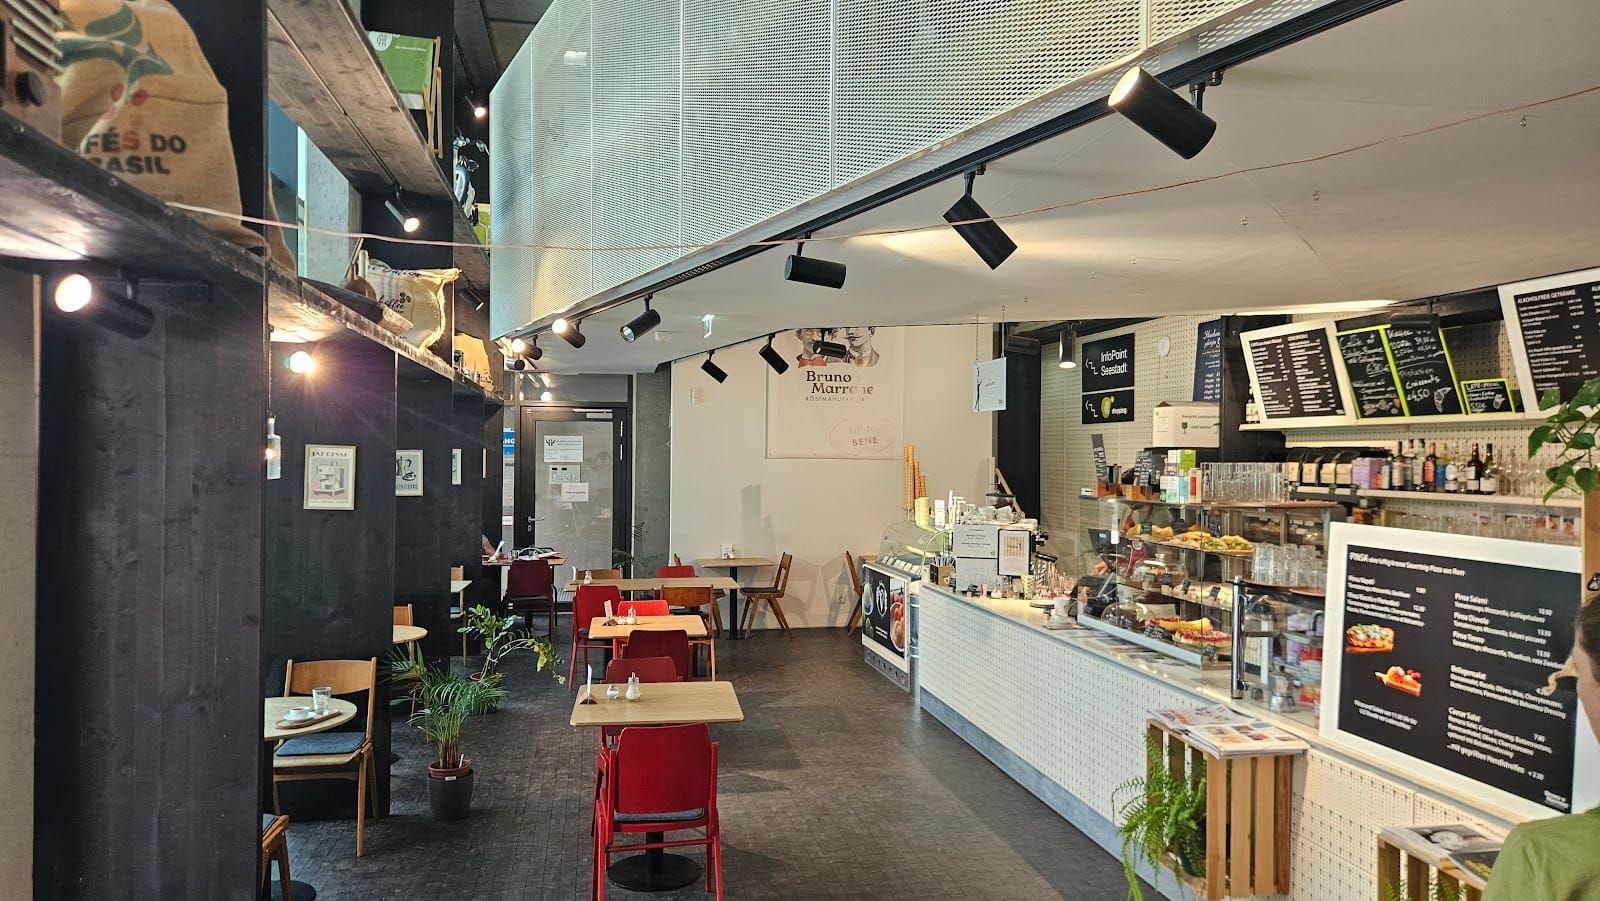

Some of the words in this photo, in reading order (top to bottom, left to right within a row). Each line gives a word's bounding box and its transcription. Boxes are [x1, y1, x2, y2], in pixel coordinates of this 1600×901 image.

[149, 133, 187, 154] DO
[90, 156, 170, 175] ASIL
[1101, 348, 1128, 362] InfoPoint
[806, 370, 852, 383] Bruno
[1101, 362, 1128, 377] Seestadt
[811, 382, 874, 395] Marre
[852, 436, 879, 447] BENE
